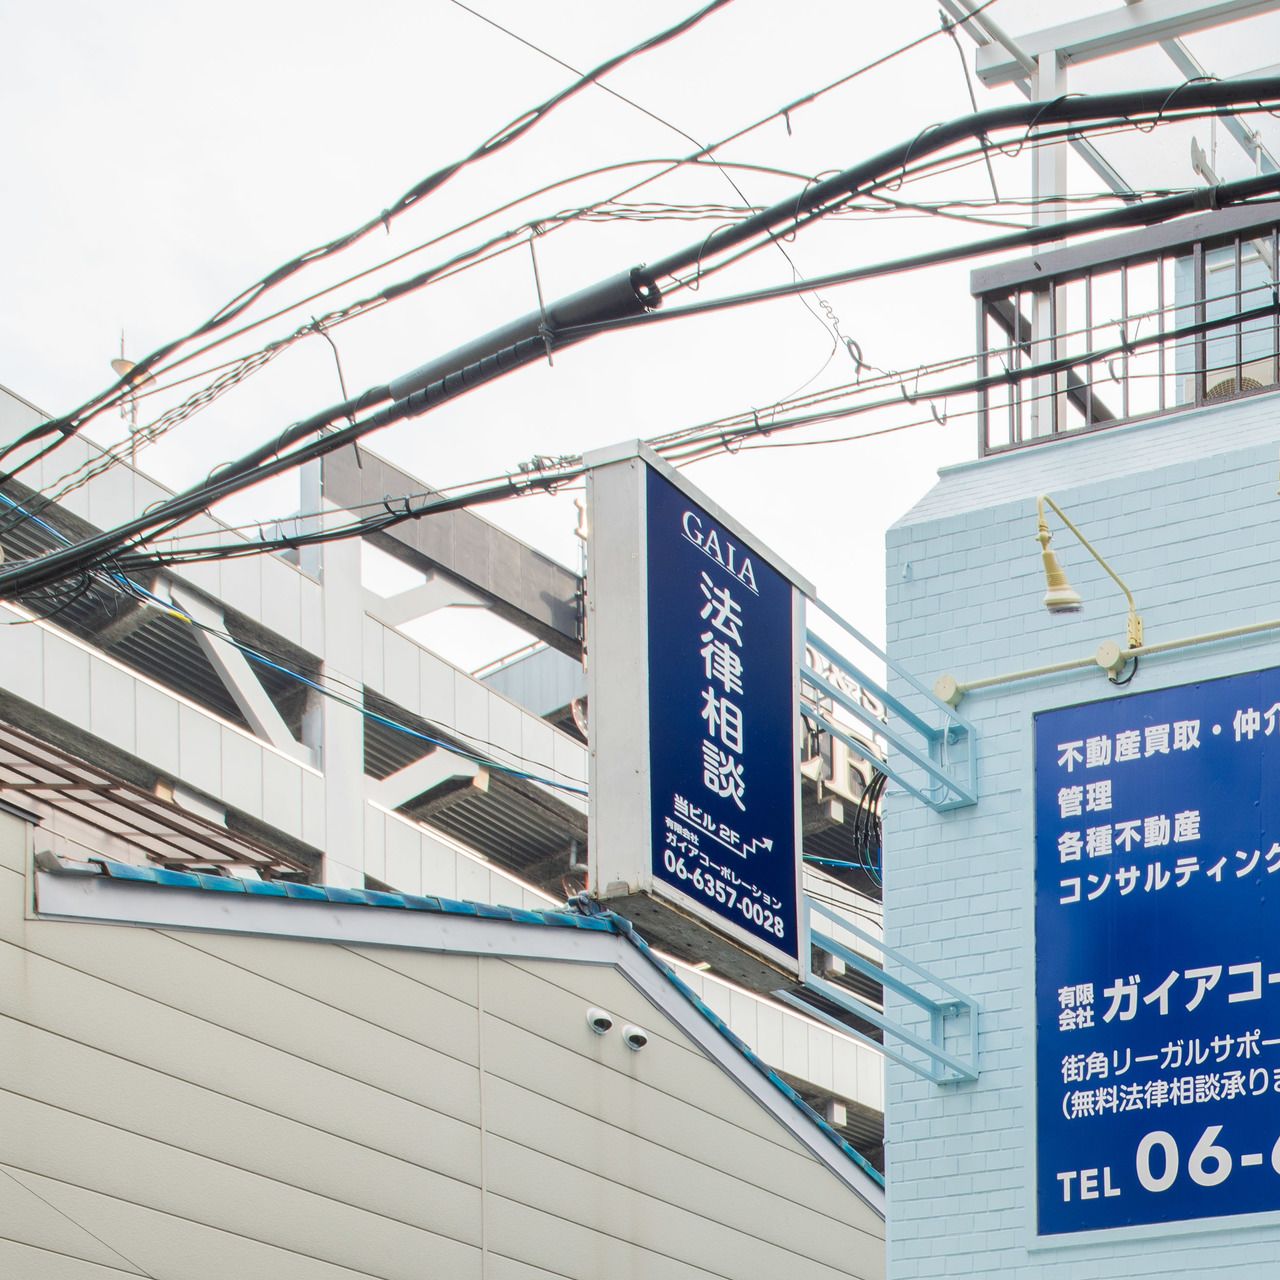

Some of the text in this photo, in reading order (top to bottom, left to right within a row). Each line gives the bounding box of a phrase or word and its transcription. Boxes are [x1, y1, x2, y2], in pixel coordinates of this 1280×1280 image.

[681, 510, 760, 592] GAIA
[700, 570, 746, 812] 法律相談
[674, 793, 740, 844] 当ビル 2F
[1057, 780, 1112, 818] 管理
[665, 816, 699, 846] 有限会社
[1057, 810, 1201, 863] 各種不動産
[664, 850, 785, 938] 06-6357-0028
[666, 832, 782, 909] ガイアコーポレーション
[1058, 984, 1094, 1008] 有限
[1058, 1006, 1094, 1031] 会社
[1057, 1168, 1121, 1202] TEL
